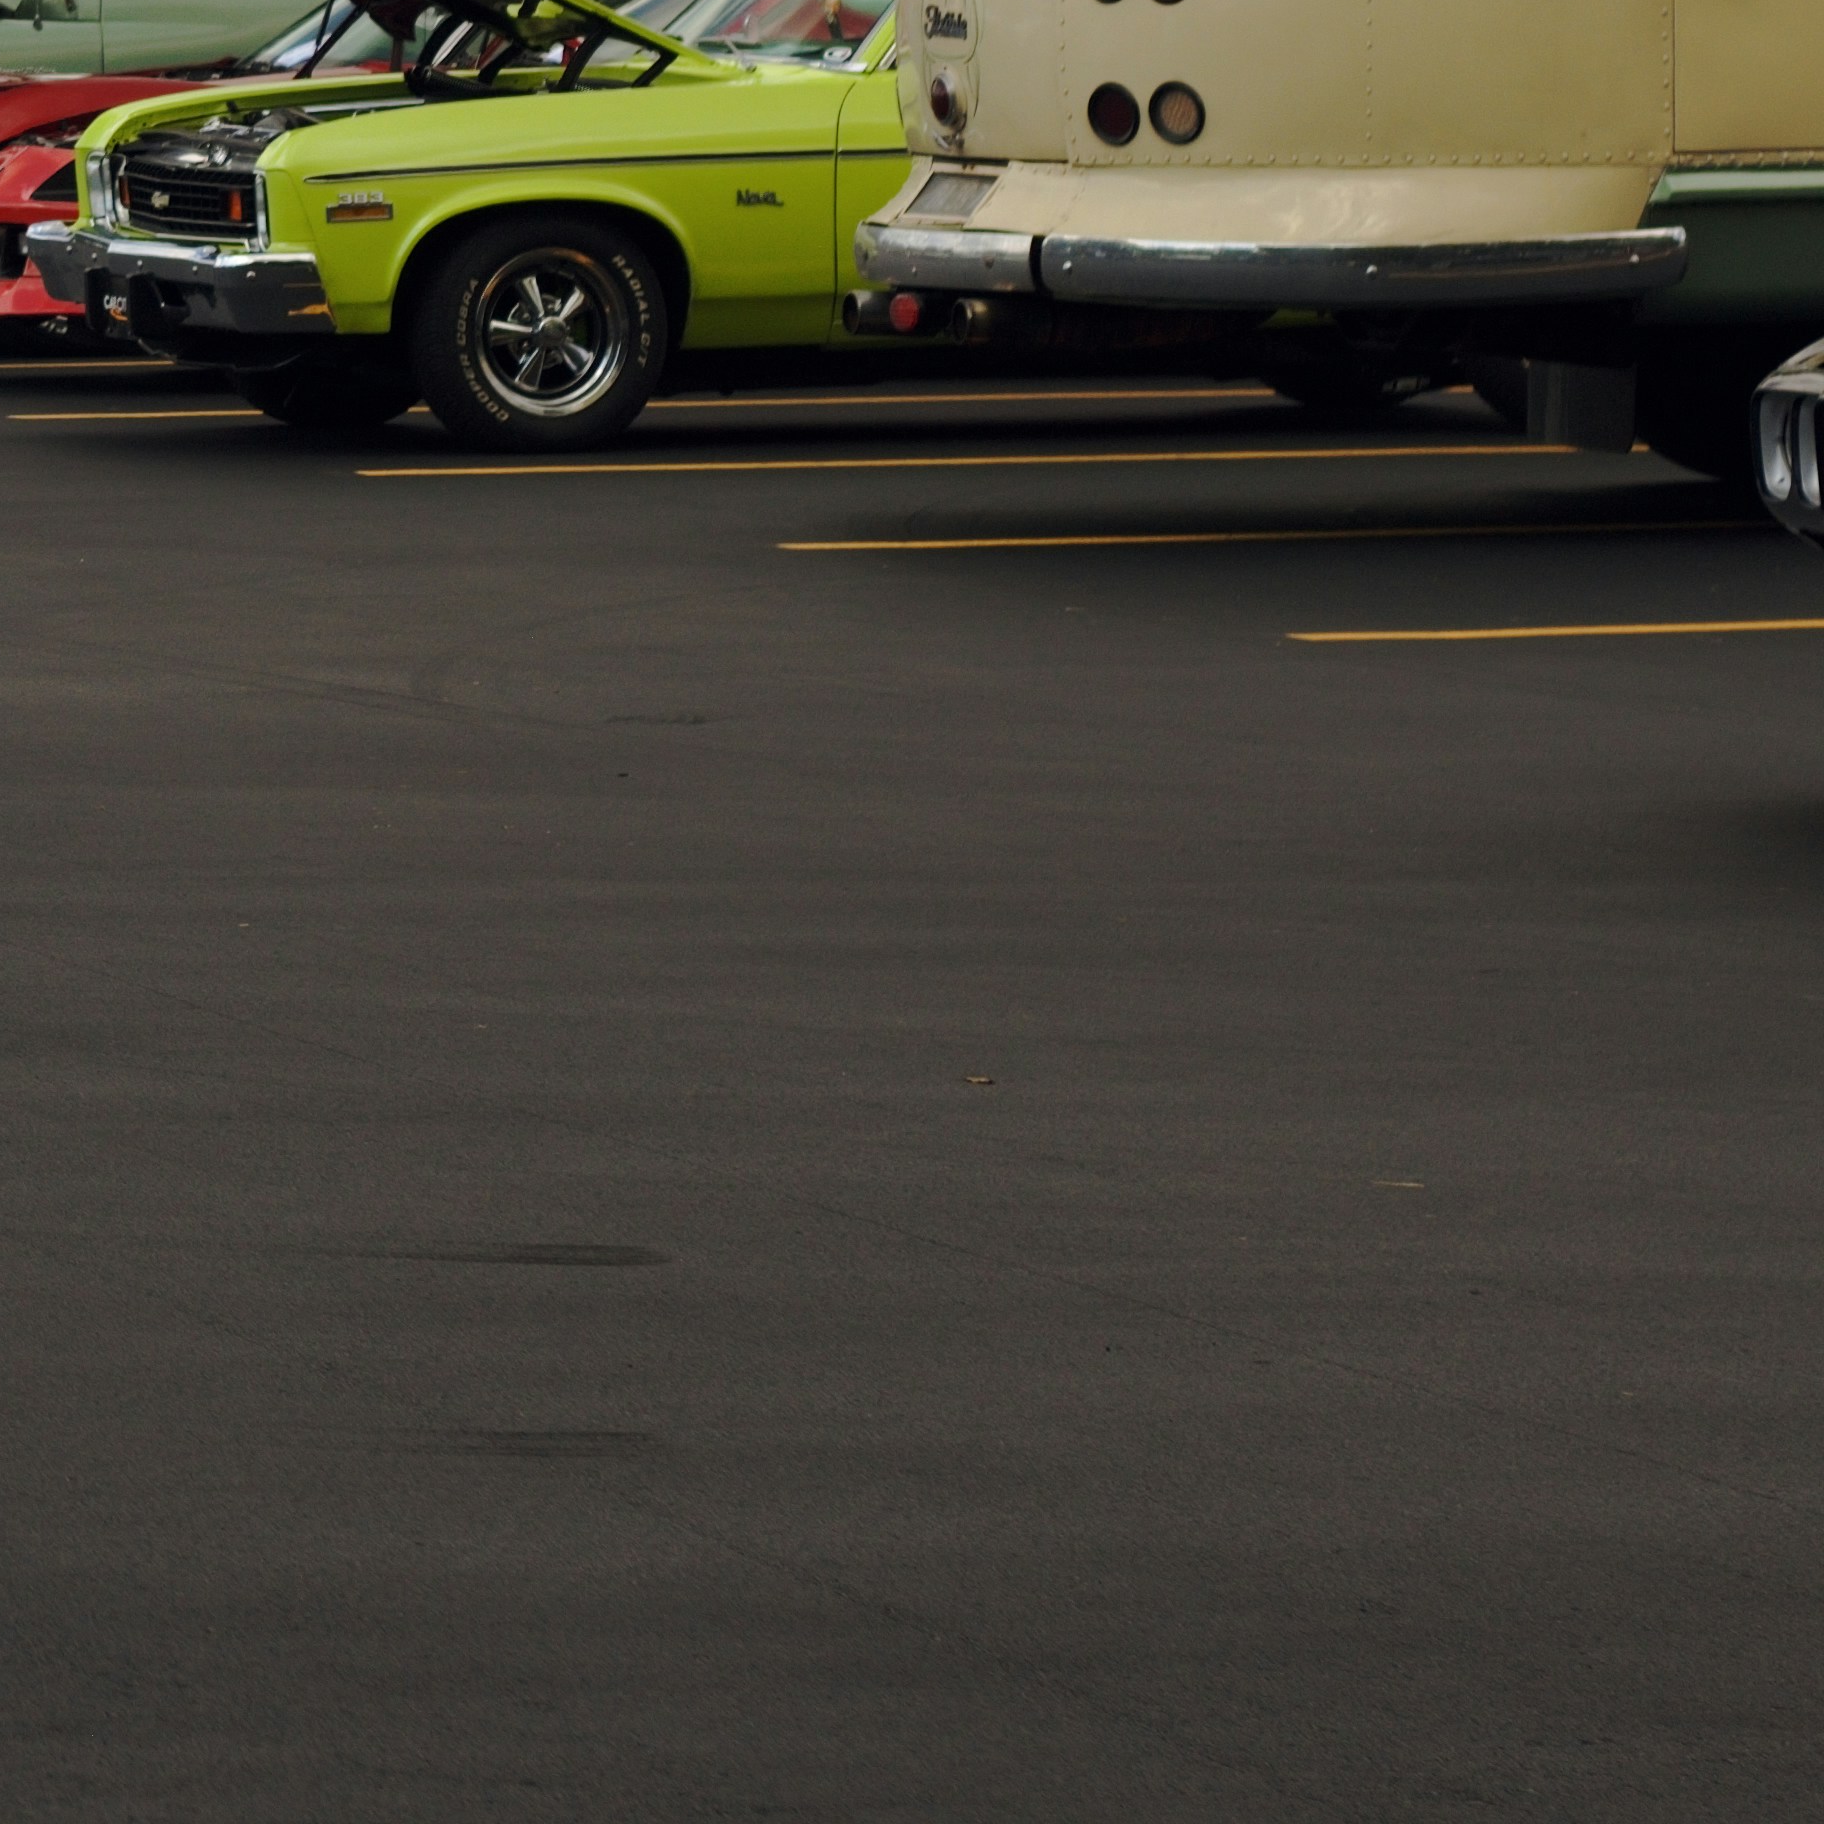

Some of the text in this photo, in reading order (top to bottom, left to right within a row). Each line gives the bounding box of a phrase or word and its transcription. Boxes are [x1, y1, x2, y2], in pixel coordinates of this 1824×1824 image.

[338, 191, 384, 205] 383
[456, 277, 480, 346] COBRA
[612, 254, 651, 324] RADIAL
[458, 353, 511, 423] COOPER
